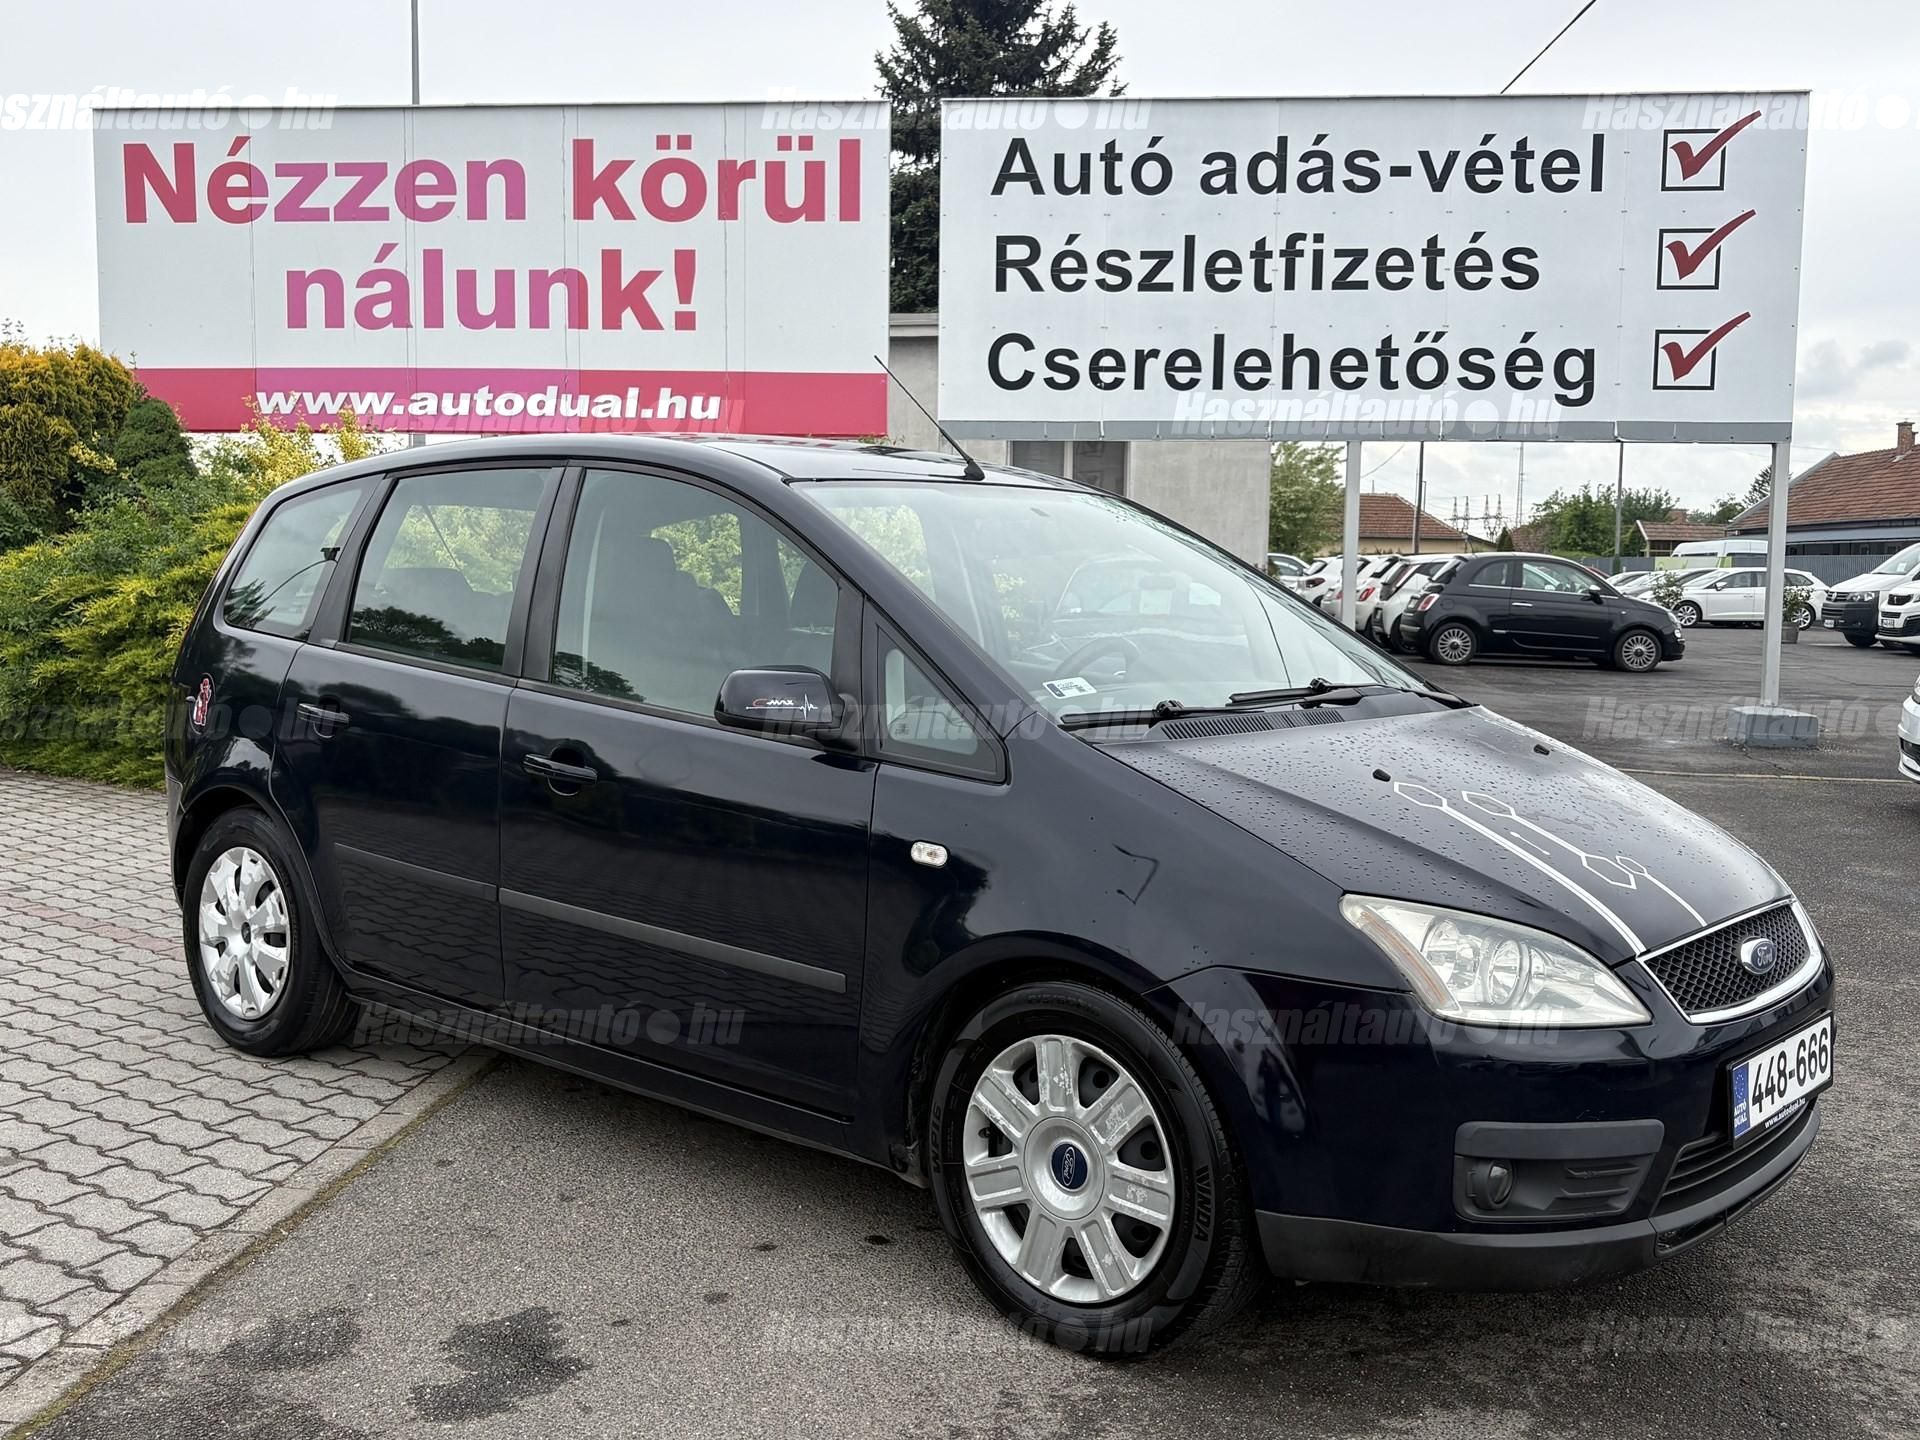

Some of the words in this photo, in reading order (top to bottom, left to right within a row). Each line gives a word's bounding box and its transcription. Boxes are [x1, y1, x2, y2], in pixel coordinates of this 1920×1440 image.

[123, 136, 526, 224] Nézzen
[573, 134, 861, 223] körül
[991, 136, 1173, 196] Autó
[1200, 133, 1605, 195] adás-vétel
[286, 243, 697, 330] nálunk!
[995, 230, 1540, 293] Részletfizetés
[256, 385, 721, 420] www.autodual.hu
[988, 331, 1596, 407] Cserelehetőség
[1751, 1026, 1829, 1113] 448-666
